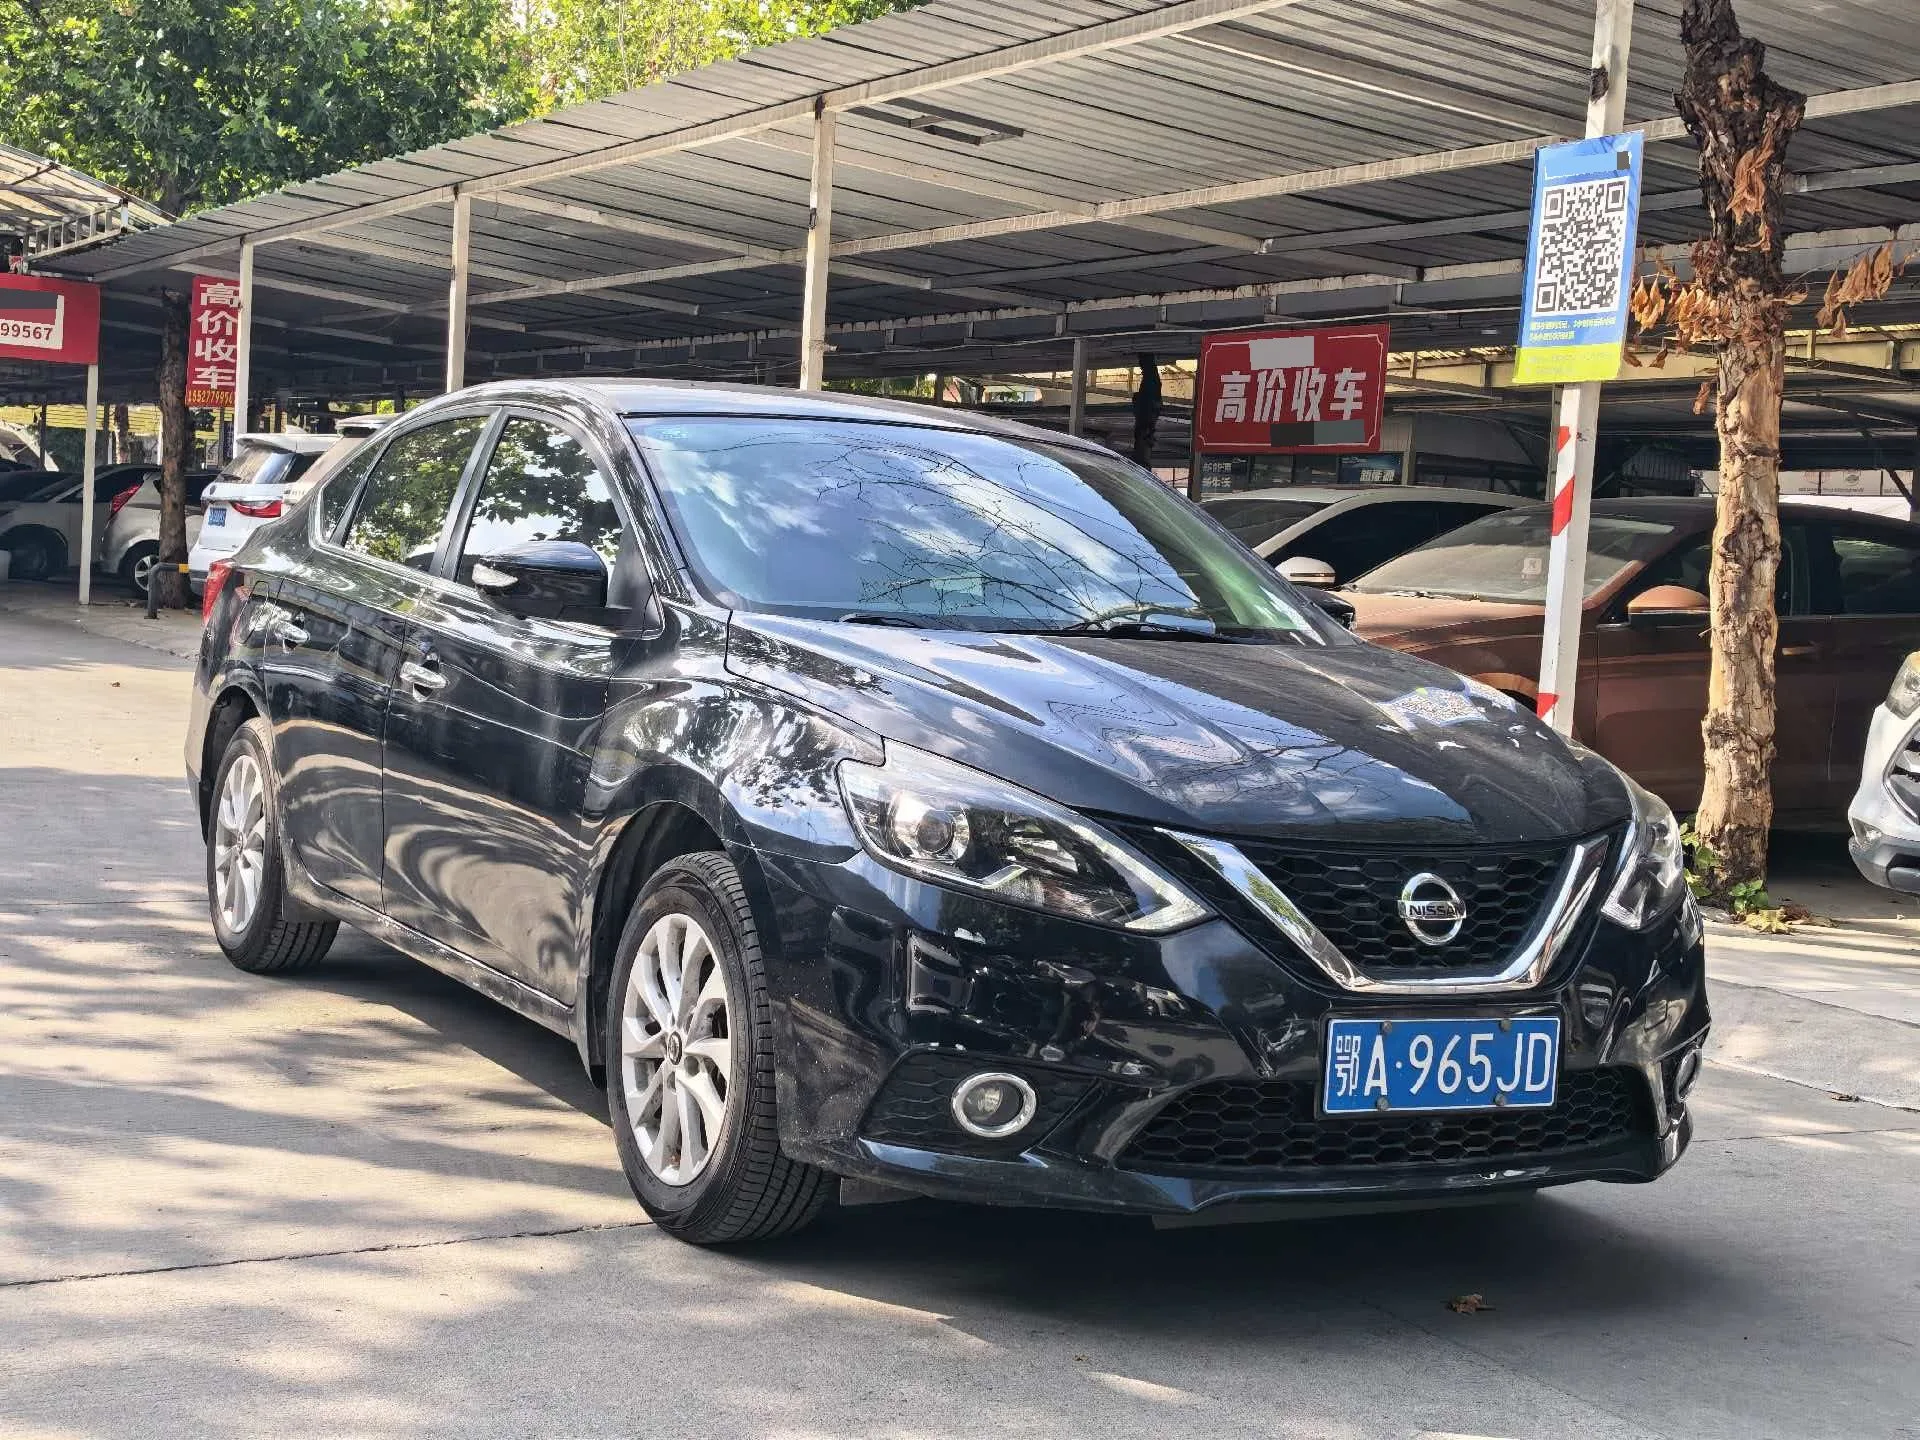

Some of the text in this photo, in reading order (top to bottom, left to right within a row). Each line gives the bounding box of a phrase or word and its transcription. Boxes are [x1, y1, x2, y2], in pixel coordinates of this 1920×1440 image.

[0, 322, 53, 341] 99567
[192, 282, 240, 389] 高价收车
[1214, 367, 1367, 423] 高价收车
[1409, 903, 1464, 917] NISSAN
[1335, 1032, 1552, 1097] 鄂A·965JD
